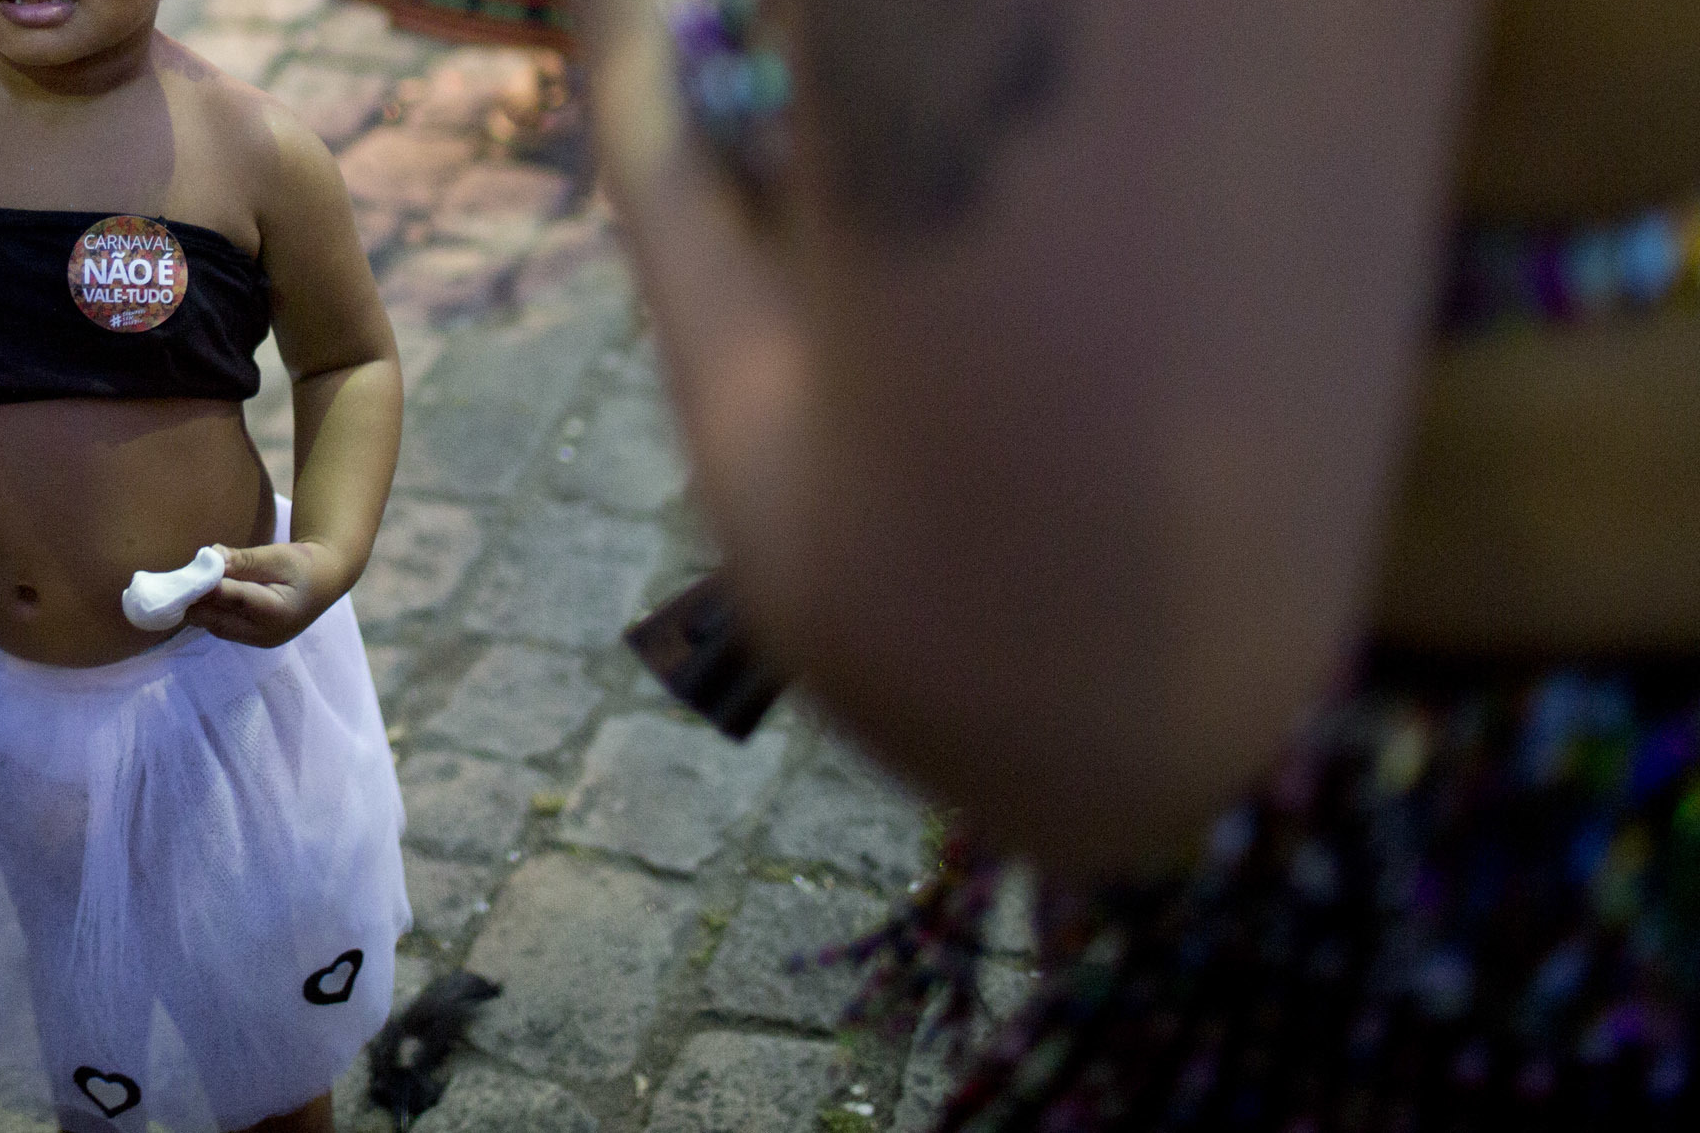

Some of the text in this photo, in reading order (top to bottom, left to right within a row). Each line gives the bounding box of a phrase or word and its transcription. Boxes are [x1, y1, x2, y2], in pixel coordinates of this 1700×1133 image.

[84, 235, 174, 251] CARNAVAL
[84, 252, 174, 286] NÃO É
[83, 288, 174, 304] VALE-TUDO
